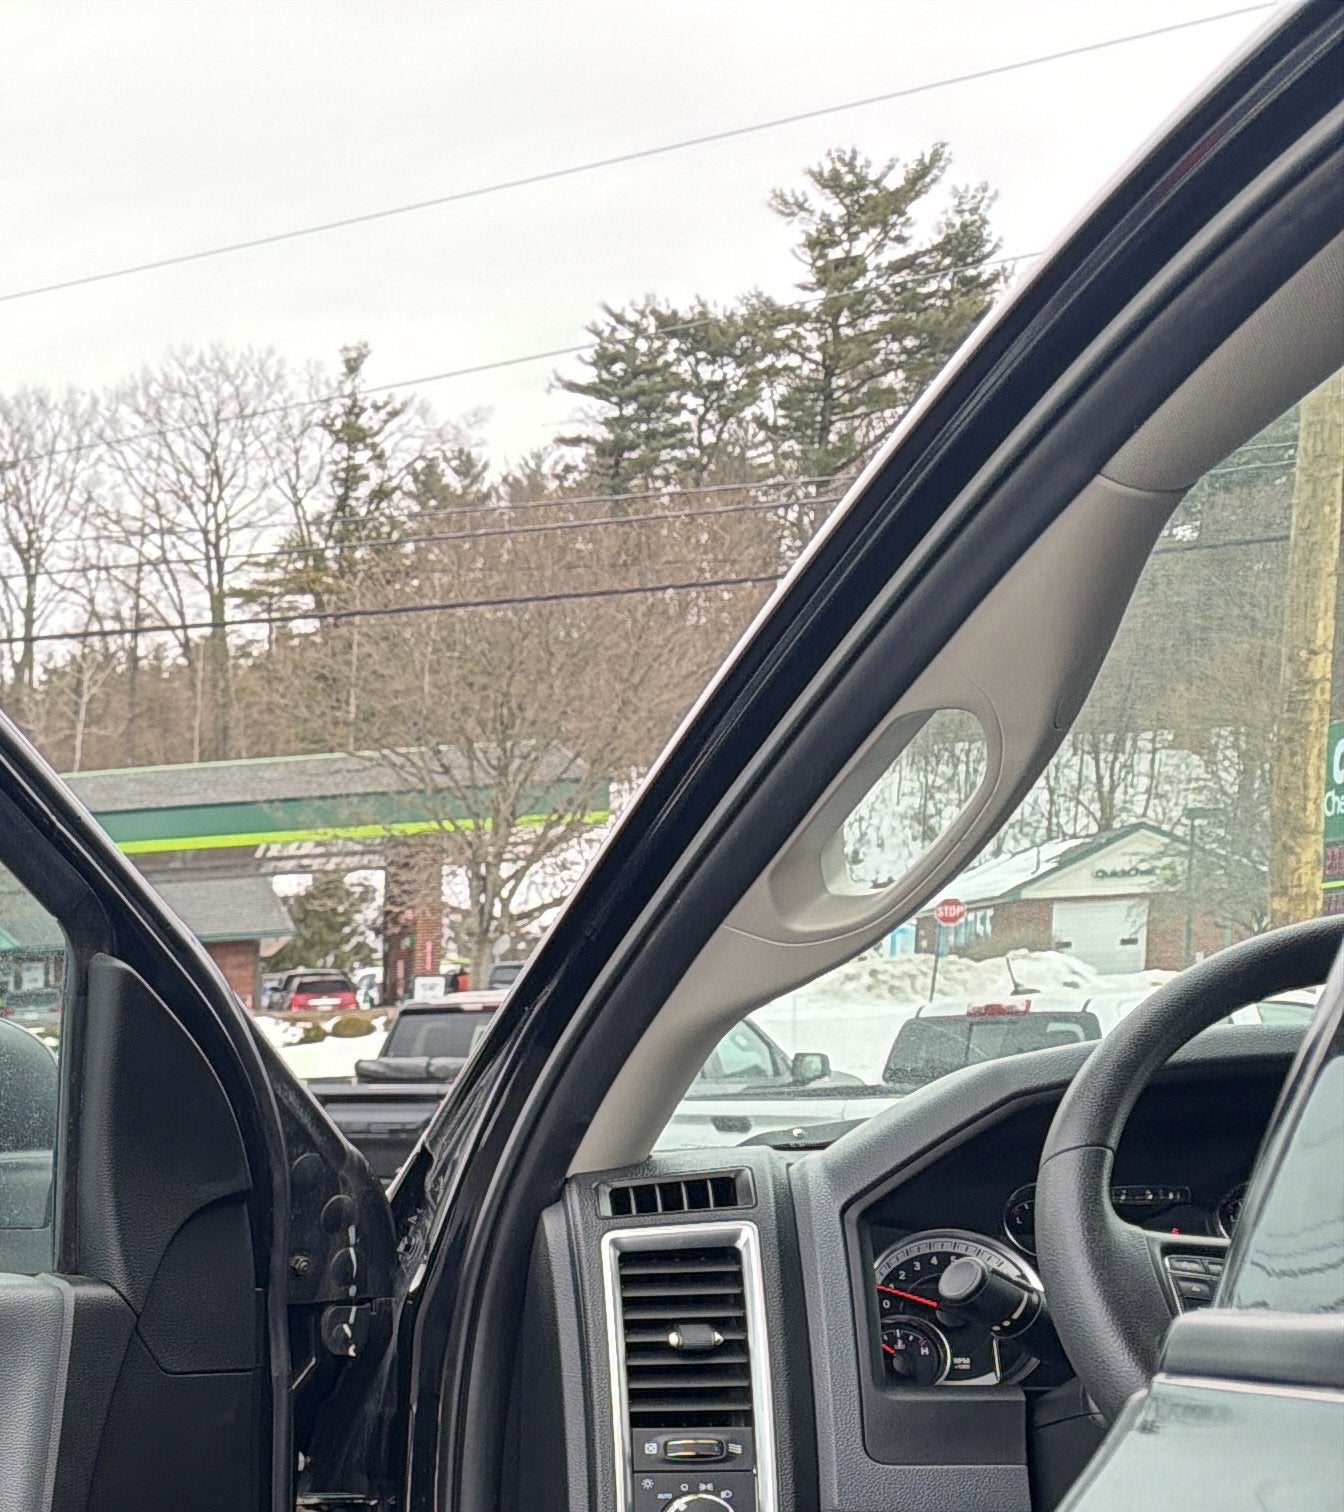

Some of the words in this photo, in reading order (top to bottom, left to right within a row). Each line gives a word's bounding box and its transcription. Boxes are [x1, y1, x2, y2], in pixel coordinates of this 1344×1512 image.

[937, 904, 965, 917] STOP
[930, 1256, 938, 1265] 4
[914, 1261, 921, 1271] 3
[899, 1271, 906, 1280] 2
